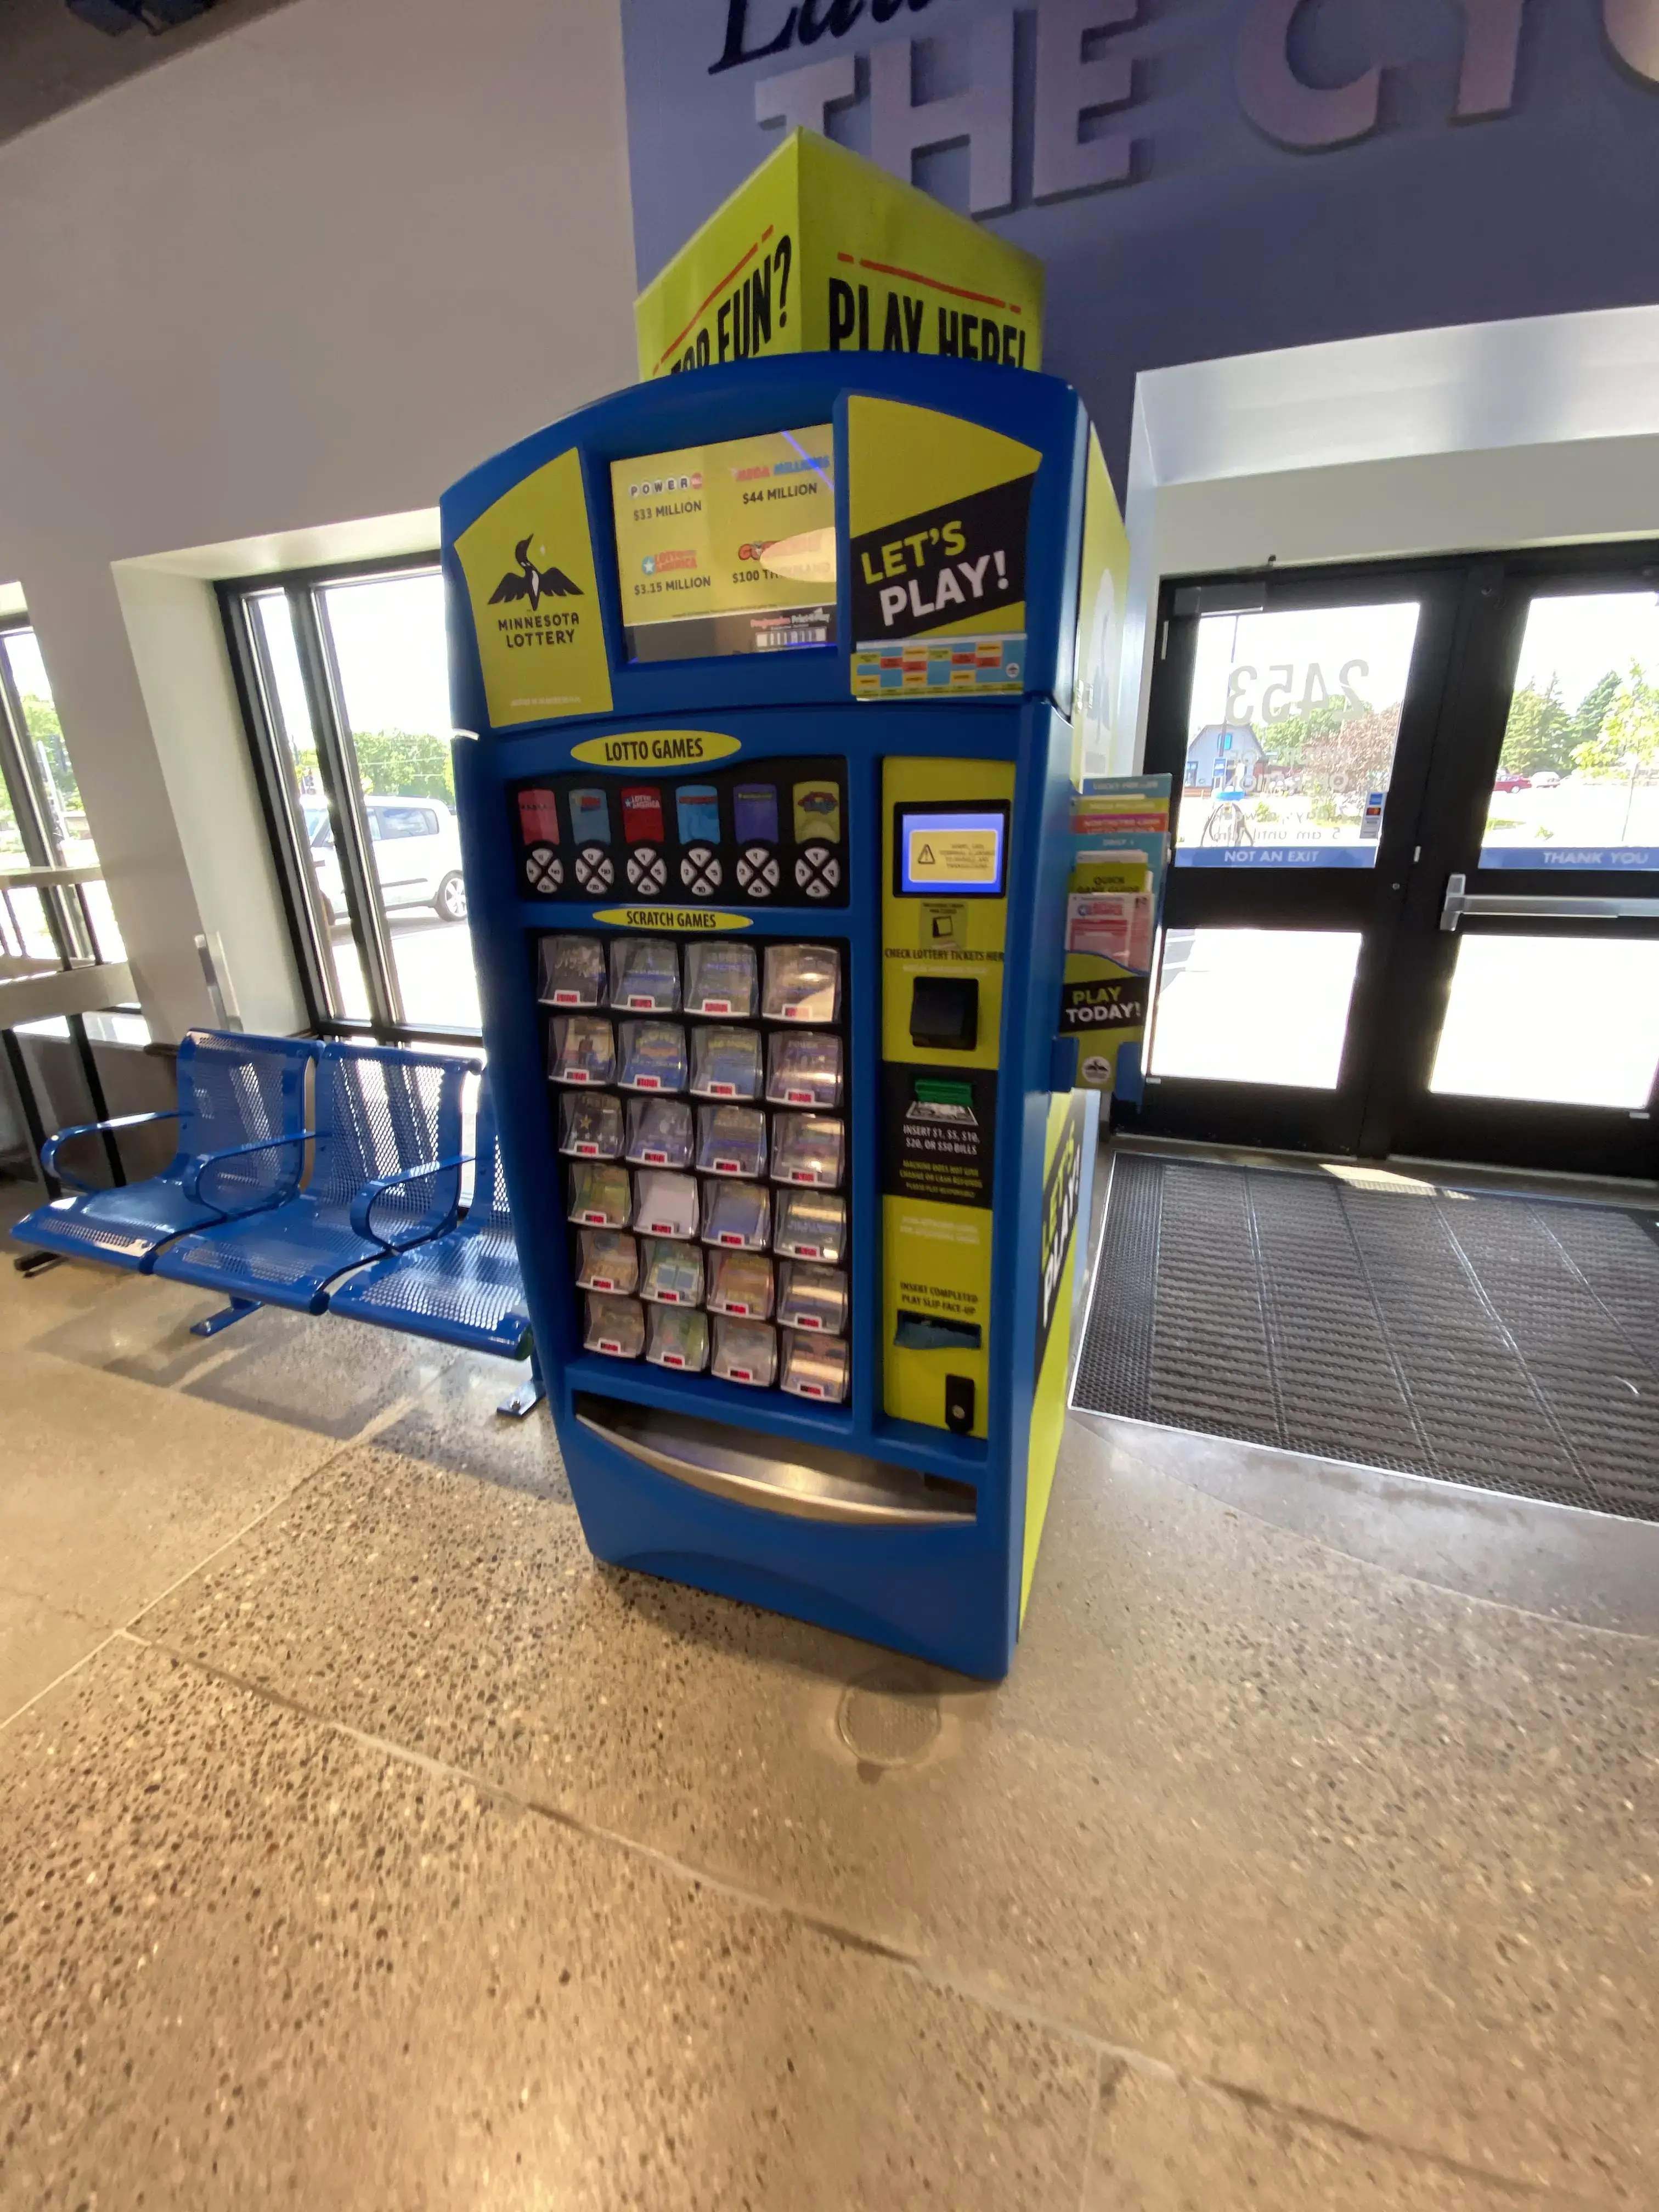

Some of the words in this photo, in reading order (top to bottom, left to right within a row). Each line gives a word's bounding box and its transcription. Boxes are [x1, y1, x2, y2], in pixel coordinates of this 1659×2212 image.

[754, 0, 1139, 212] THE
[718, 235, 792, 364] FUN?
[742, 491, 764, 504] $44
[768, 483, 817, 500] MILLION
[633, 507, 652, 521] $33
[656, 500, 702, 518] MILLION
[861, 520, 966, 585] LET'S
[634, 582, 662, 595] $3.15
[665, 576, 711, 591] MILLION
[732, 570, 760, 584] $100
[879, 549, 1009, 627] PLAY!
[498, 612, 579, 631] MINNESOTA
[506, 629, 575, 648] LOTTERY
[605, 741, 648, 761] LOTTO
[652, 738, 703, 759] GAMES
[1224, 851, 1256, 862] NOT
[1260, 851, 1283, 862] AN
[1288, 851, 1320, 862] EXIT
[1543, 852, 1604, 864] THANK
[1610, 852, 1649, 864] YOU
[627, 911, 674, 927] SCRATCH
[677, 913, 716, 928] GAMES
[885, 948, 911, 958] CHECK
[913, 949, 948, 960] LOTTERY
[1072, 986, 1122, 1006] PLAY
[1065, 1001, 1141, 1023] TODAY!
[900, 1281, 928, 1294] INSERT
[902, 1294, 921, 1306] PLAY
